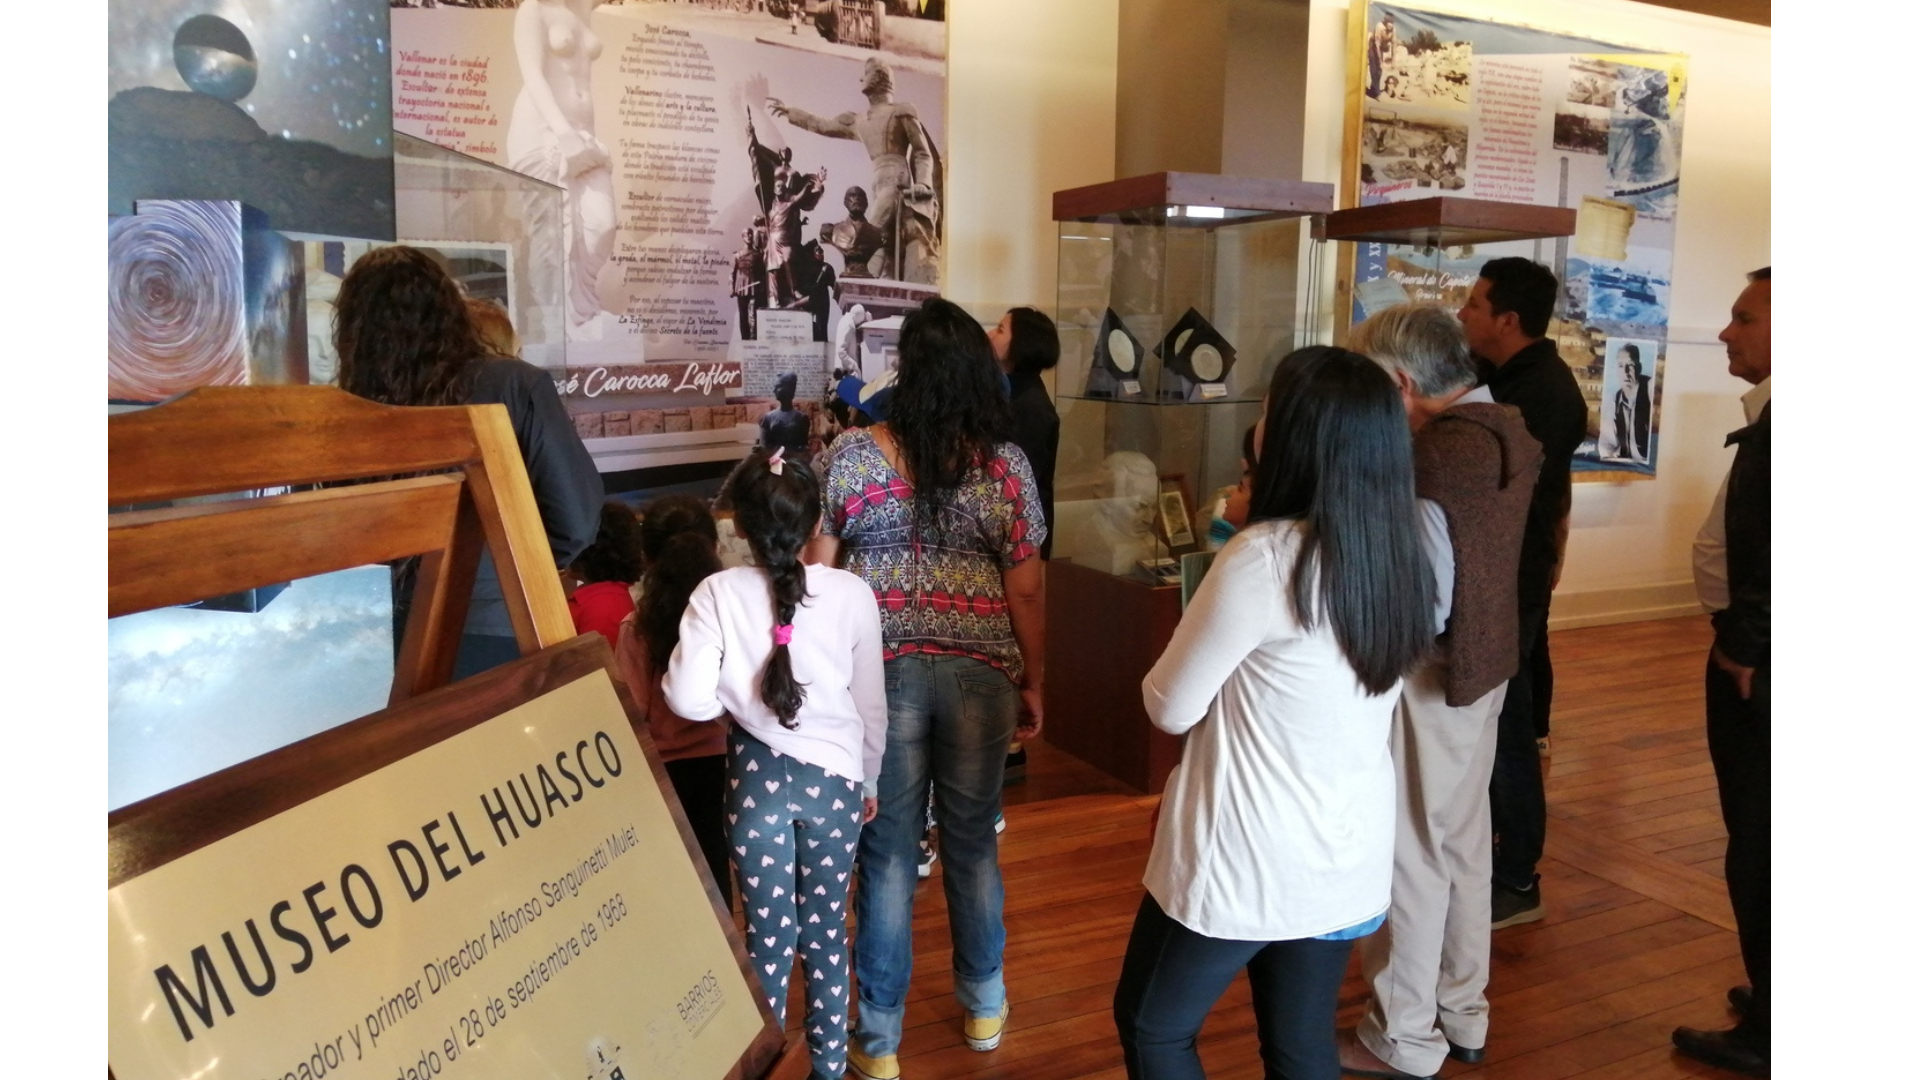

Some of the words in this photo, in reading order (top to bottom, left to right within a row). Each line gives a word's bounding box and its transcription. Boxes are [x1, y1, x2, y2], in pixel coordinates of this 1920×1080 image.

[399, 50, 437, 64] Vallenar
[439, 57, 447, 66] es
[450, 54, 457, 66] la
[460, 56, 490, 69] ciudad
[396, 63, 421, 77] donde
[424, 70, 446, 80] nació
[449, 73, 458, 81] en
[401, 80, 437, 93] Escultor
[445, 82, 454, 94] de
[457, 86, 487, 97] extensa
[398, 95, 445, 112] trayectoria
[448, 99, 485, 111] nacional
[453, 116, 461, 124] es
[463, 115, 486, 125] autor
[488, 113, 498, 126] de
[425, 123, 434, 136] la
[437, 127, 466, 138] estatua
[1388, 270, 1427, 285] Mineral
[1426, 275, 1436, 285] de
[553, 372, 579, 396] sé
[584, 367, 671, 398] Carocca
[673, 362, 740, 396] Laflor
[153, 863, 384, 1043] MUSEO
[387, 810, 486, 903] DEL
[480, 730, 622, 847] HUASCO
[347, 1023, 362, 1061] y
[365, 979, 423, 1048] primer
[423, 932, 489, 995] Director
[489, 897, 543, 949] Alfonso
[540, 844, 609, 908] Sanguinetti
[605, 823, 640, 863] Mulet
[443, 1026, 462, 1062] el
[459, 1009, 485, 1047] 28
[485, 996, 507, 1027] de
[507, 936, 581, 1009] septiembre
[580, 921, 599, 947] de
[597, 892, 628, 932] 1968
[677, 969, 718, 1021] BARRIOS
